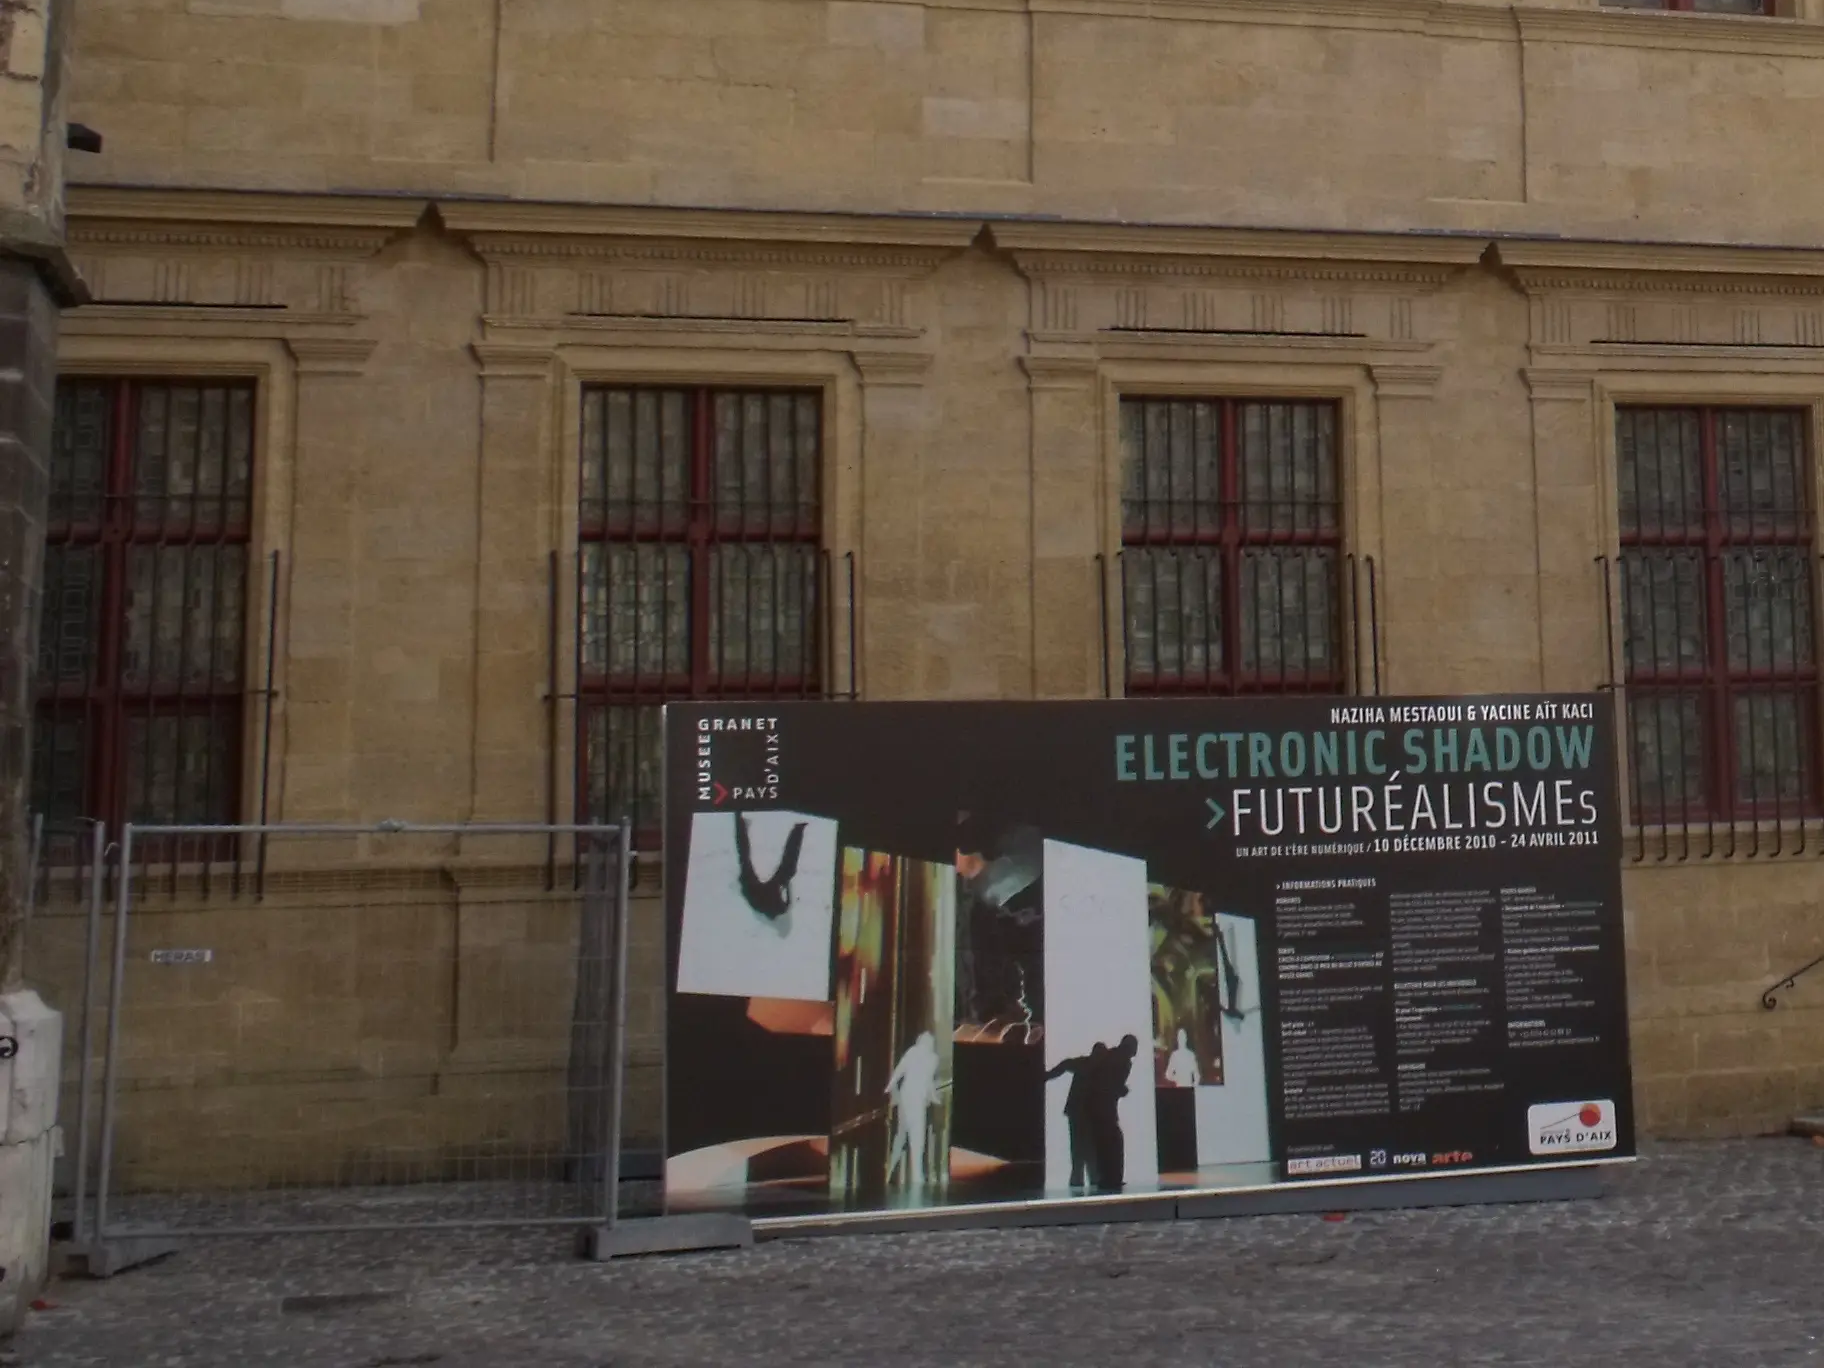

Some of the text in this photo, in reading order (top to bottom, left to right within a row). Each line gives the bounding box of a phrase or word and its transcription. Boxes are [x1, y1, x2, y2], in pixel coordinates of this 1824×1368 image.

[698, 717, 778, 731] GRANET
[1331, 700, 1594, 724] NAZIHA MESTAOUI & YACINE AÏT KACI
[764, 733, 779, 783] D'AIX
[1115, 725, 1595, 781] ELECTRONIC SHADOW
[698, 733, 711, 800] MUSEE
[733, 785, 778, 799] PAYS
[1251, 846, 1268, 857] ART
[1270, 845, 1282, 856] DE
[1374, 838, 1390, 852] 10
[1394, 834, 1461, 852] DÉCEMBRE
[1465, 834, 1496, 849] 2010
[1511, 833, 1526, 848] 24
[1529, 832, 1565, 847] AVRIL
[1569, 830, 1599, 845] 2011
[1540, 1133, 1571, 1145] PAYS
[1576, 1130, 1611, 1142] D'AIX
